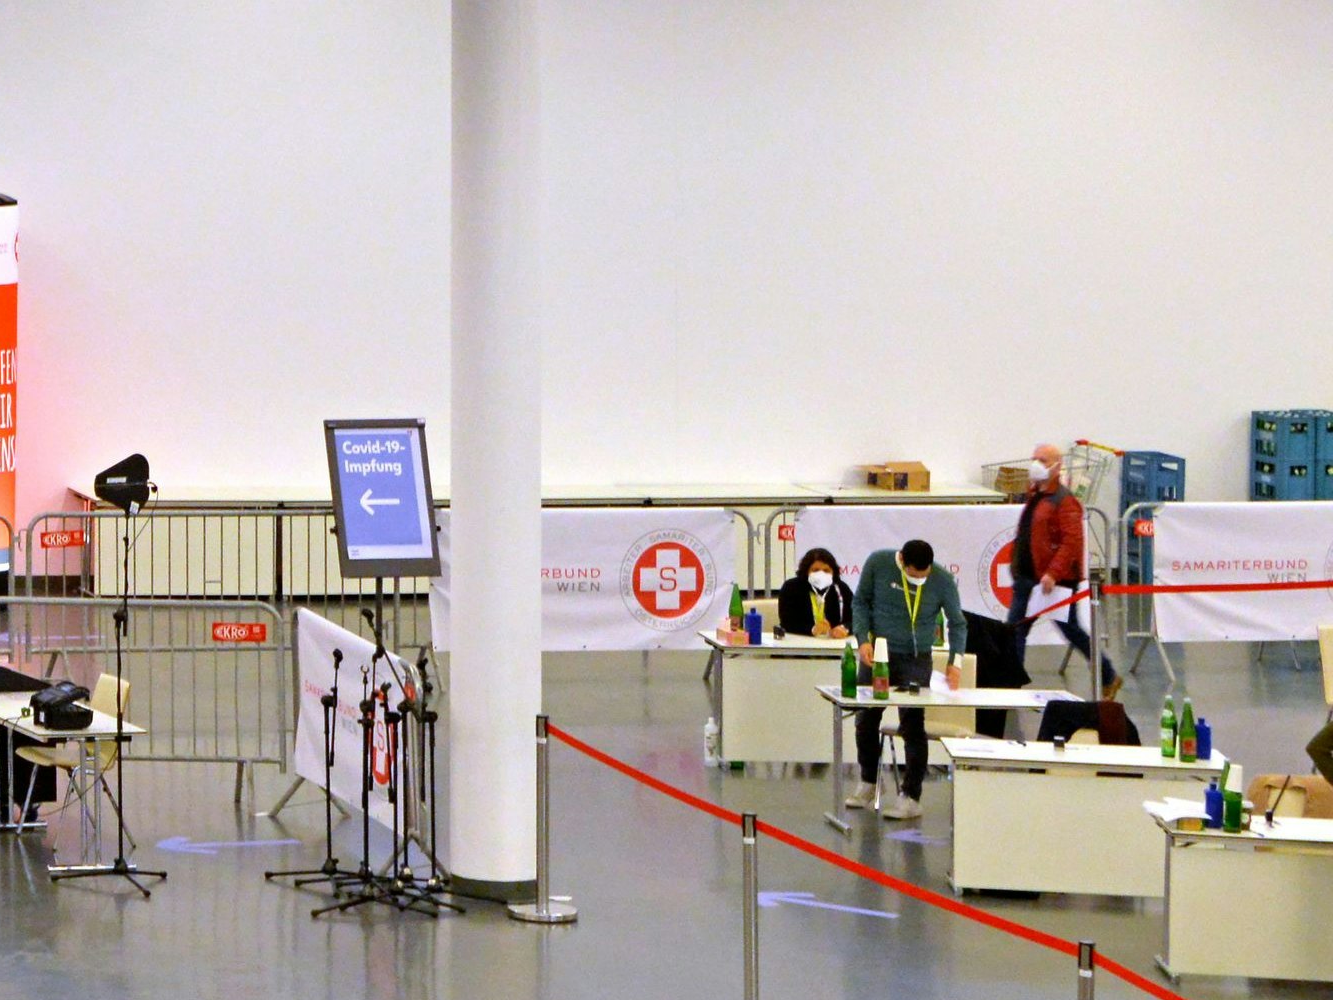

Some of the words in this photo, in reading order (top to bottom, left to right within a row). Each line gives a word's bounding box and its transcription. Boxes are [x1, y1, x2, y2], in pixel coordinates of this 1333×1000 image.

[342, 440, 406, 455] Covid-19-
[344, 459, 402, 476] Impfung
[1171, 559, 1308, 572] SAMARITERBUND
[659, 567, 677, 591] S
[556, 582, 600, 592] WIEN
